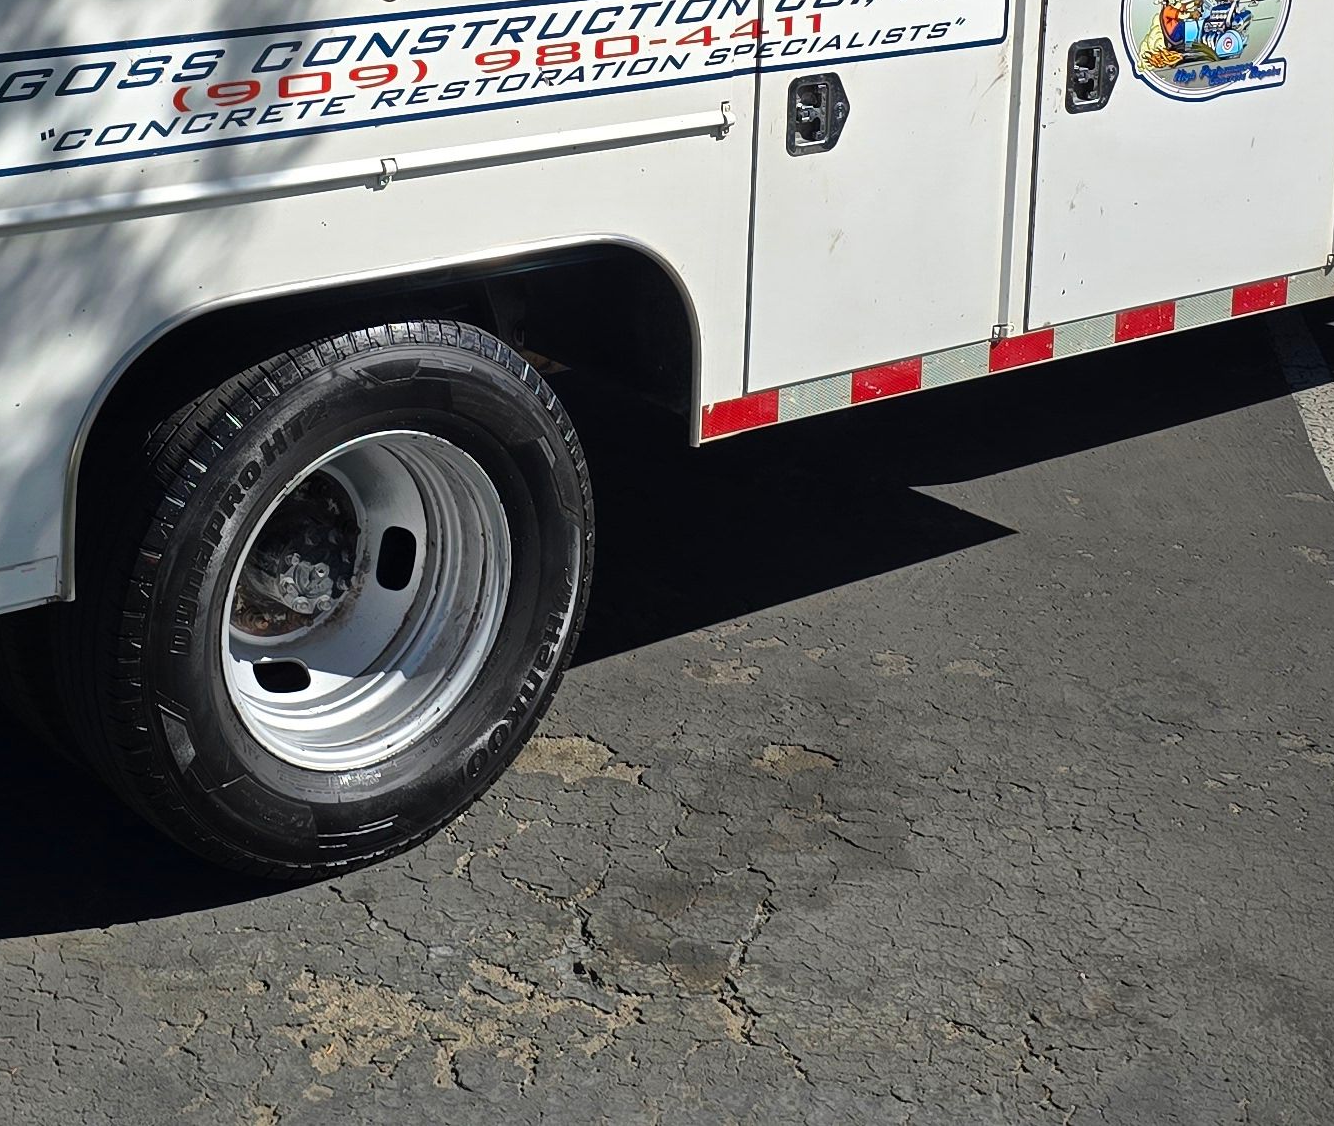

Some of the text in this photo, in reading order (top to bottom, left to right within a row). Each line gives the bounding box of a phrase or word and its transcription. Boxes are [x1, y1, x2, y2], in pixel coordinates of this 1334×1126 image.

[39, 17, 967, 152] "CONCRETE RESTORATION SPECIALISTS"
[172, 12, 823, 113] (909) 980-4411
